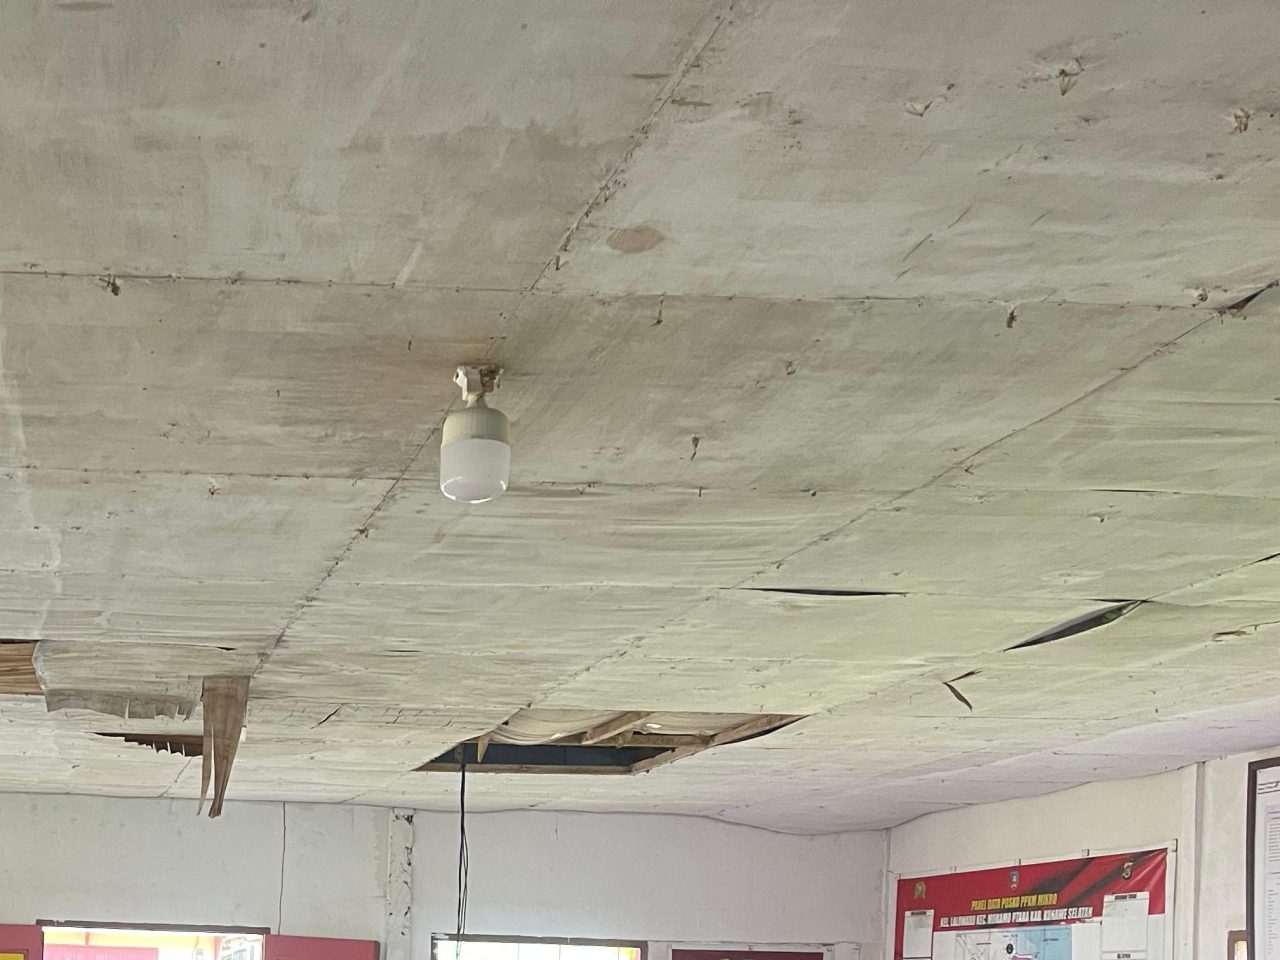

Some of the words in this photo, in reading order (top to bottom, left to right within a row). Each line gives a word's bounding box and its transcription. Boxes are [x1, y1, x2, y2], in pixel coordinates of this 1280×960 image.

[1001, 896, 1020, 909] POSKO
[1020, 894, 1038, 907] PPKM
[1038, 893, 1058, 906] MIKRO
[1012, 910, 1029, 923] UTARA
[1043, 908, 1067, 921] KONAWE
[1067, 906, 1094, 919] SELATAN
